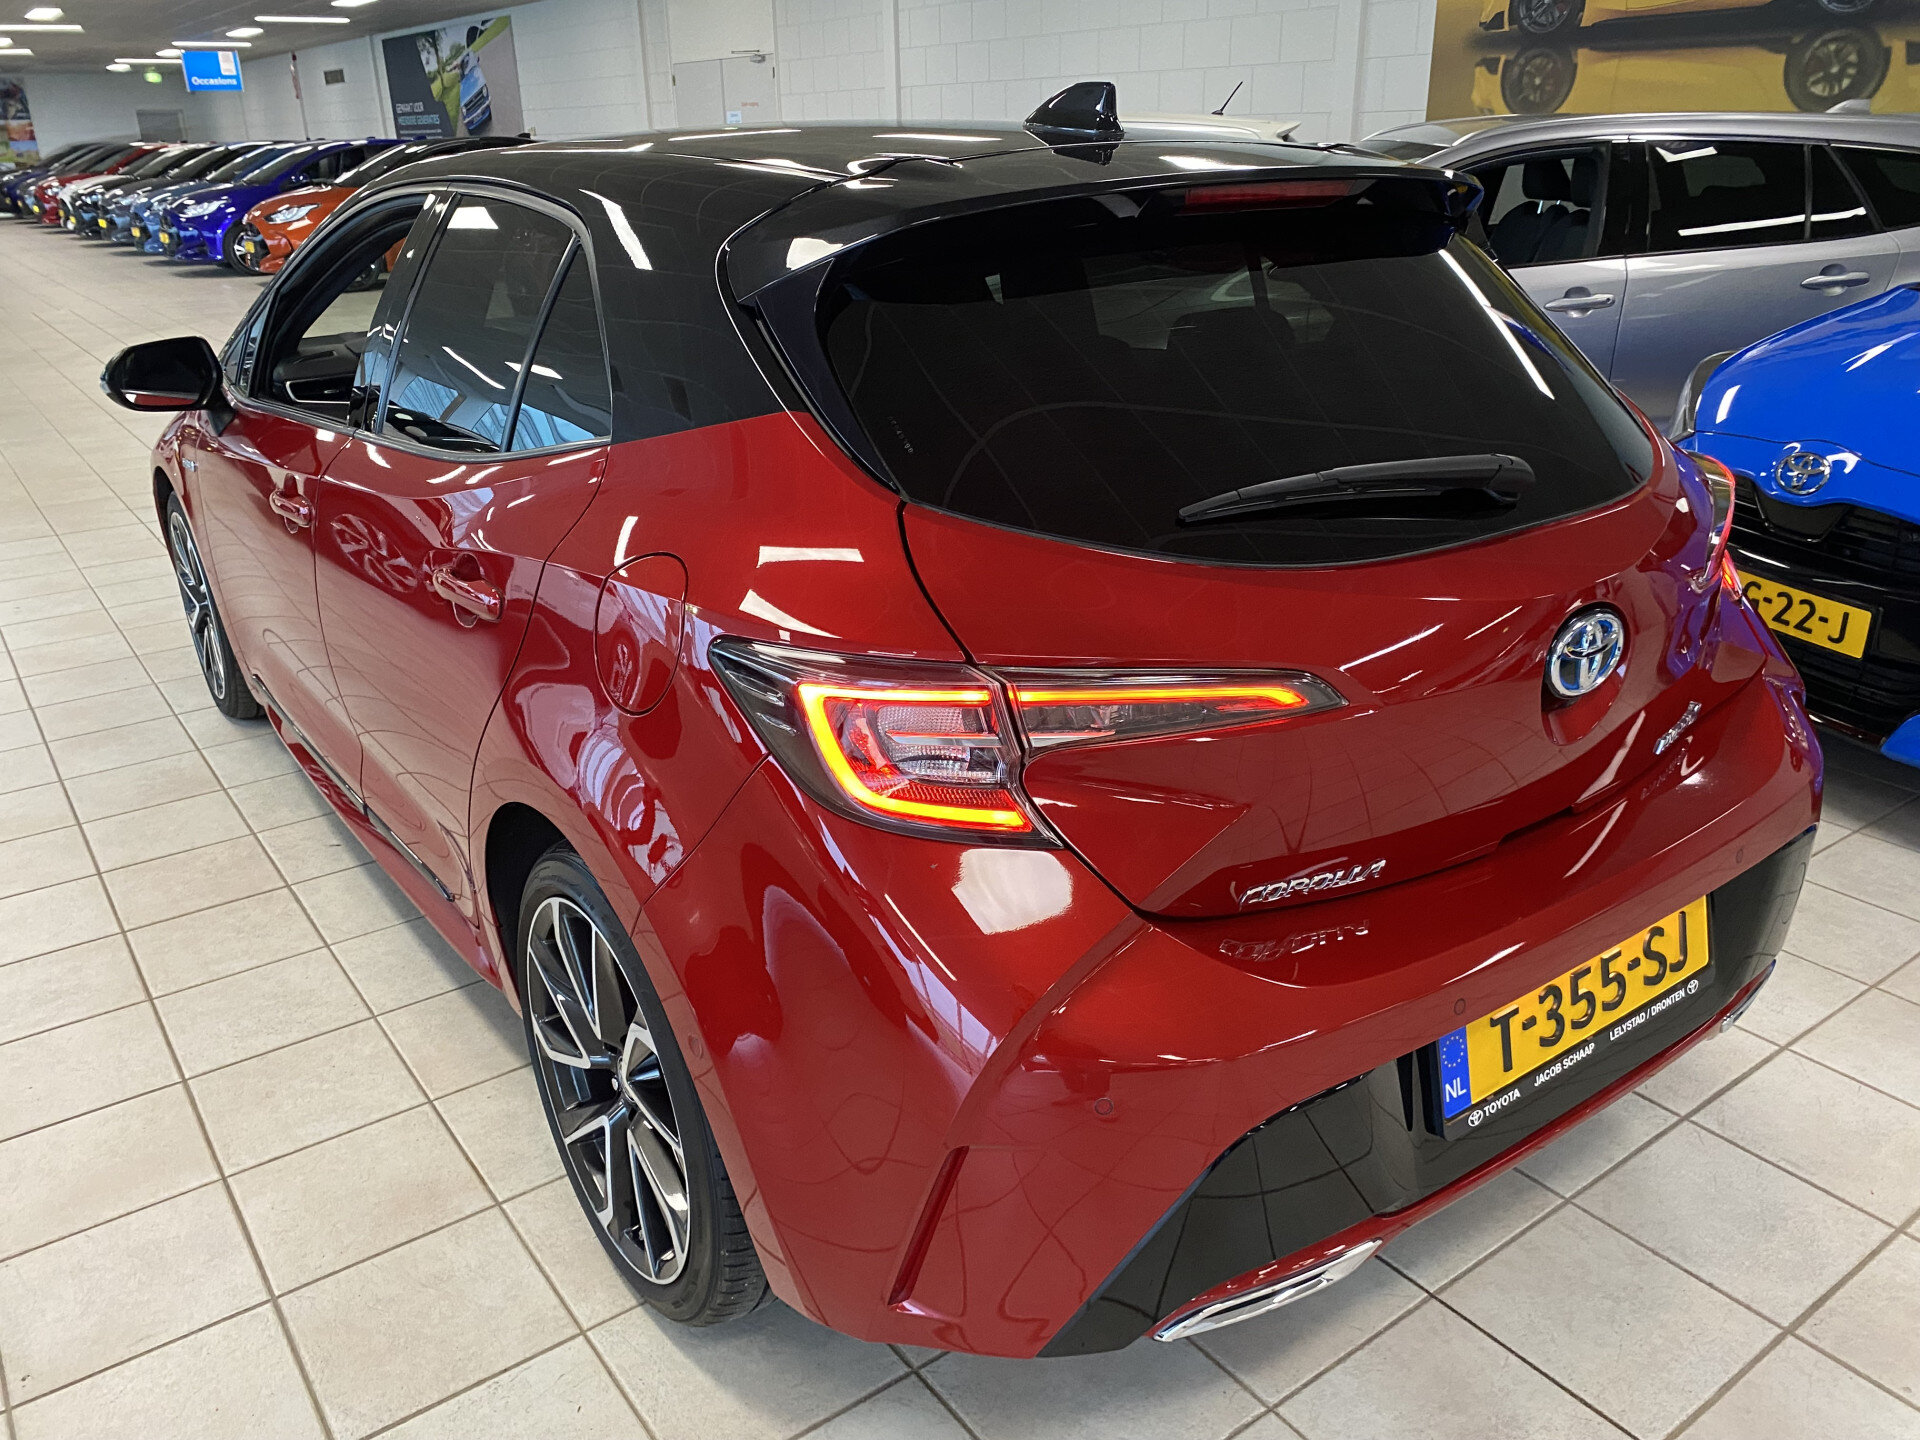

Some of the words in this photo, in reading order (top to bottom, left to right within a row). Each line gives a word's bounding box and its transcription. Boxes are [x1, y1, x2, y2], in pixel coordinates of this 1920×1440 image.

[191, 76, 237, 86] Occasions
[1742, 581, 1850, 644] G-22-J
[1238, 857, 1387, 905] COROLLA
[1489, 911, 1688, 1073] T-355-SJ
[1484, 1088, 1521, 1117] TOYOTA
[1534, 1061, 1562, 1087] JACOB
[1562, 1043, 1595, 1071] SCHAAP
[1609, 1012, 1646, 1041] LELYSTAD
[1651, 989, 1685, 1017] DRONTEN
[1445, 1078, 1467, 1103] NL
